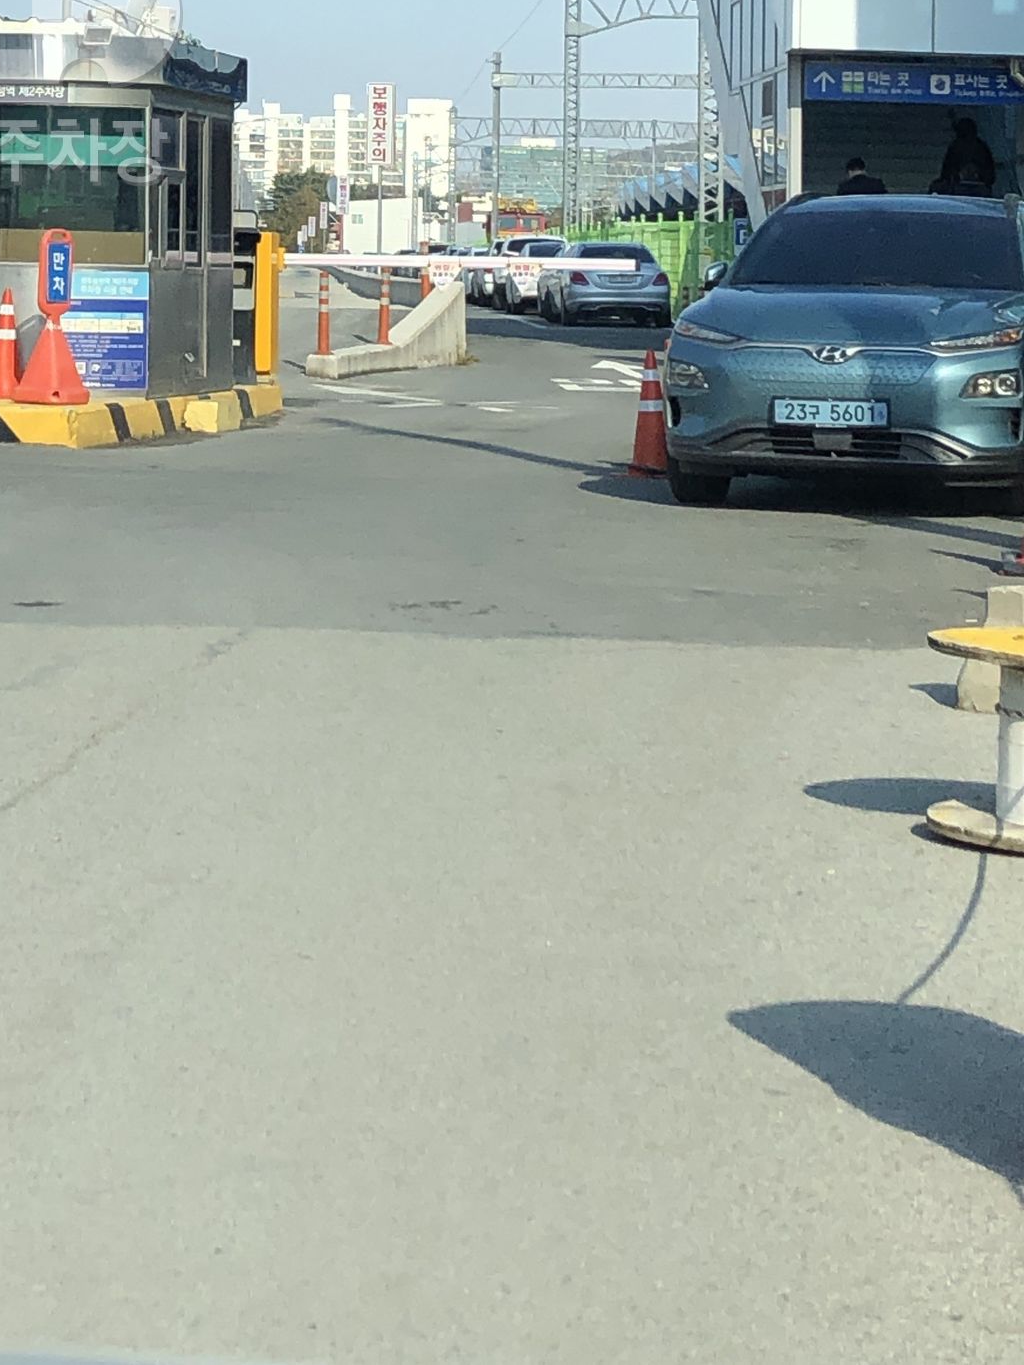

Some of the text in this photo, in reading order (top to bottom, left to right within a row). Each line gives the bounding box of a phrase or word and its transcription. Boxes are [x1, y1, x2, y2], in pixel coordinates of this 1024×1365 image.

[371, 86, 387, 162] 보행자주의
[784, 403, 874, 422] 23구 5601
